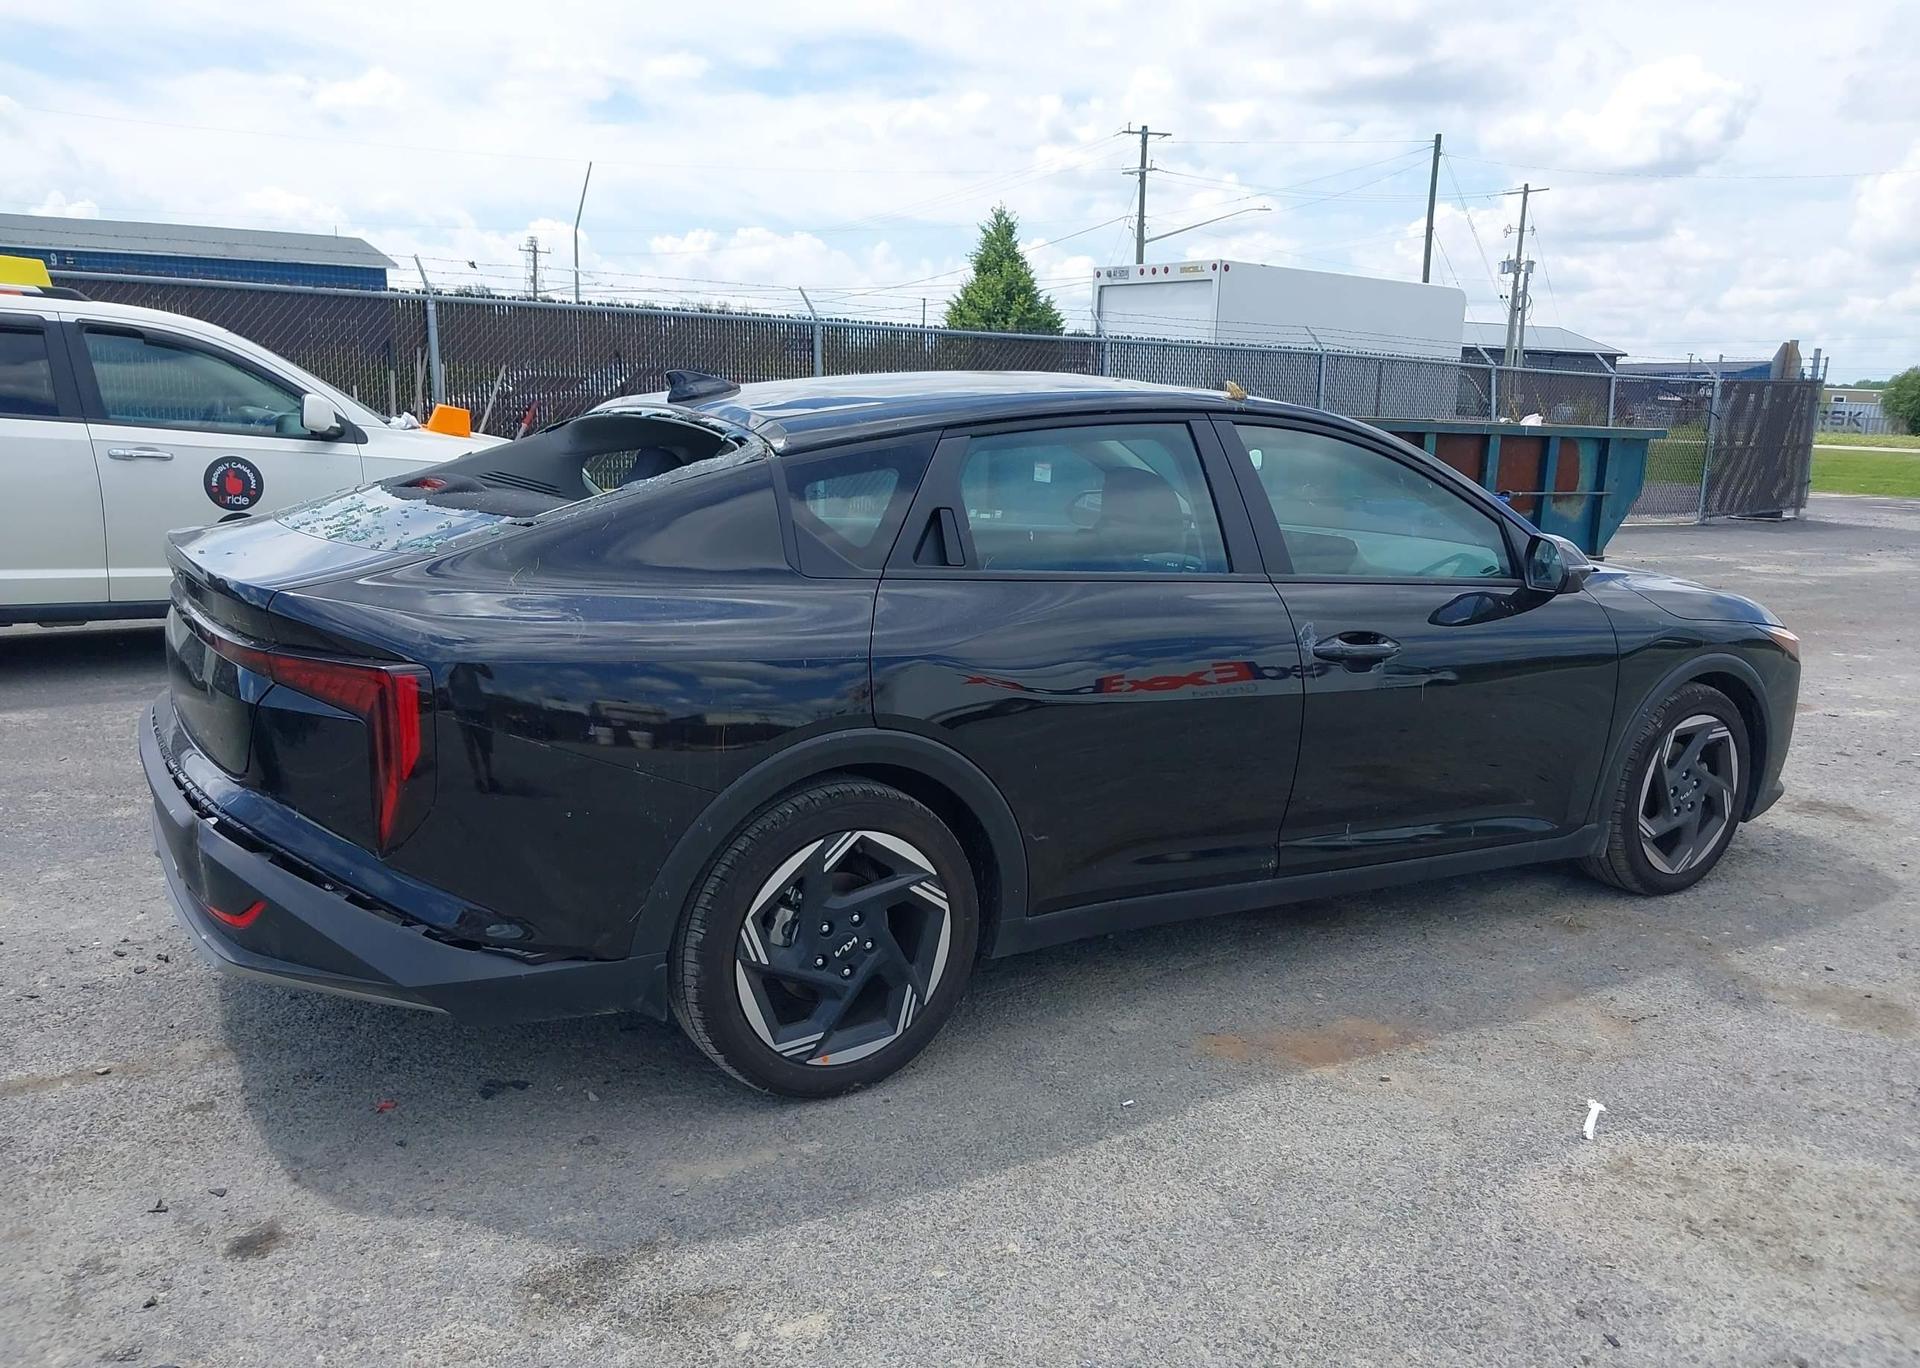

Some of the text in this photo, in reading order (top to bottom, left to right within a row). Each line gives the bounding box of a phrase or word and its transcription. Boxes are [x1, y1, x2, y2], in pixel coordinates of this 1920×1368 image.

[211, 461, 257, 489] PROUDLY CANADIAN
[218, 494, 249, 505] uride
